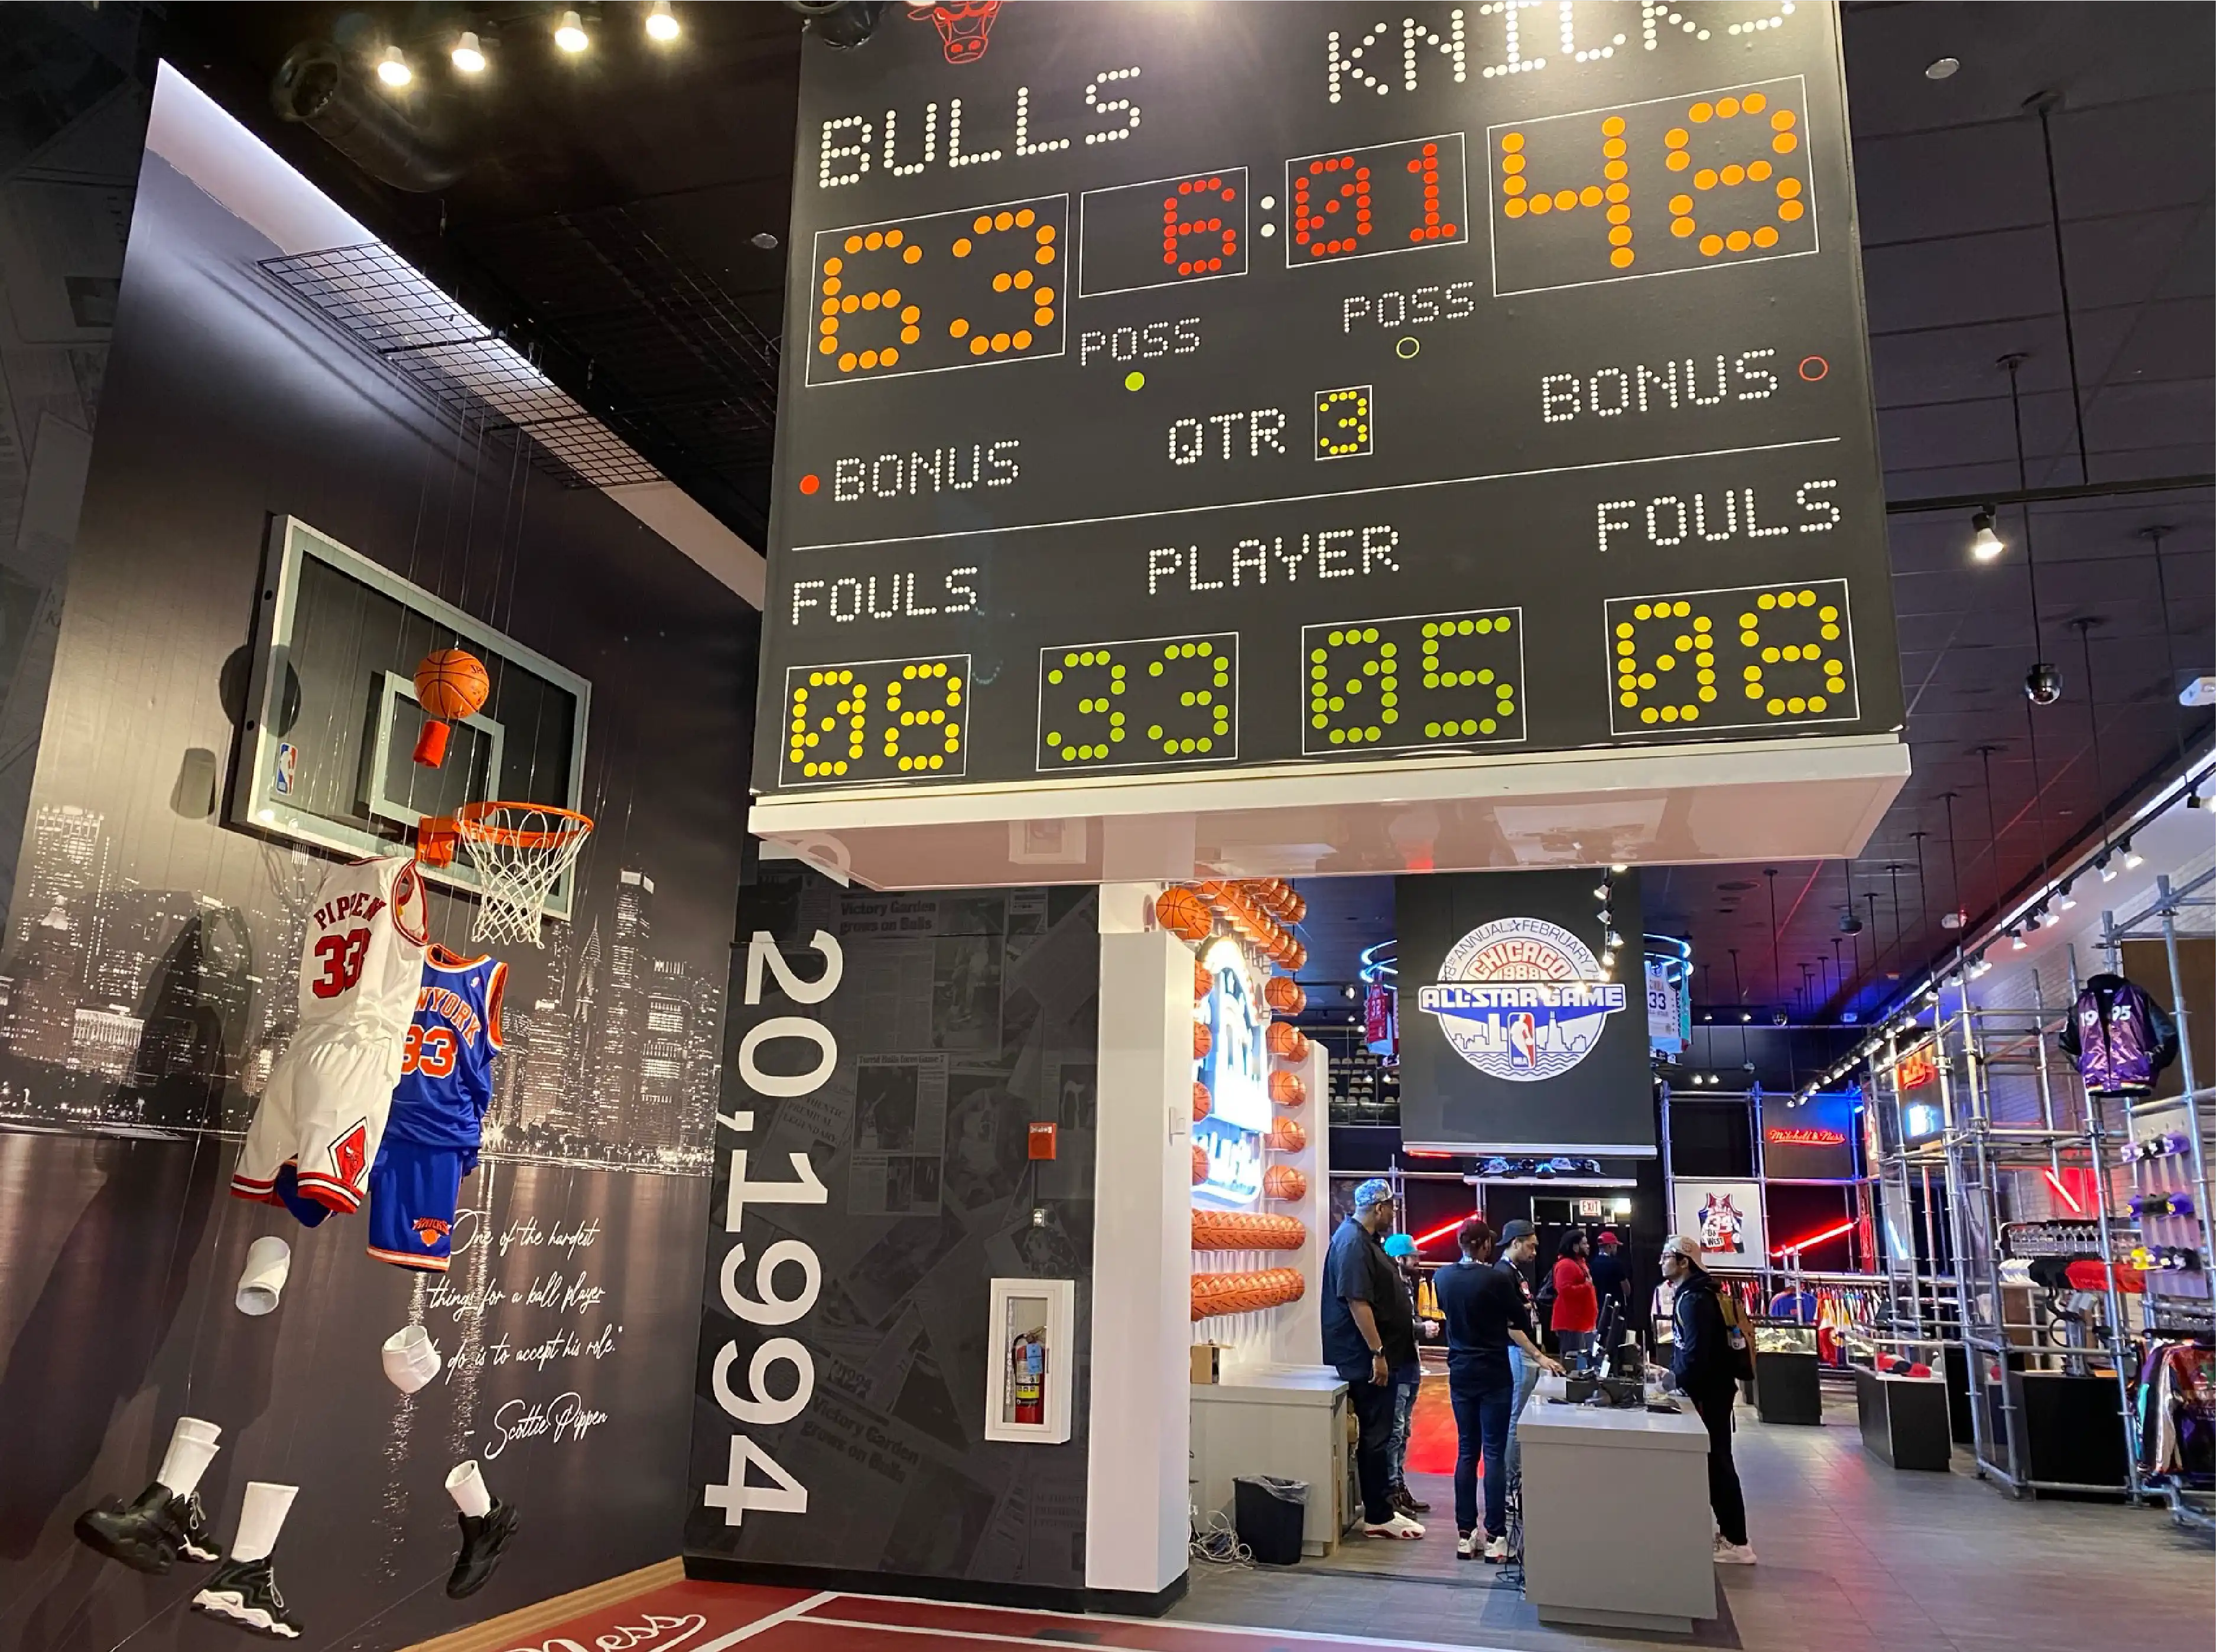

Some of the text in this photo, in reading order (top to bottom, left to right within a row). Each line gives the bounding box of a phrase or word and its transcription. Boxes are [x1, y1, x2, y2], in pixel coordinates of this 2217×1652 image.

[819, 66, 1141, 188] BULLS
[1503, 93, 1804, 269] 48
[819, 209, 1057, 372] 63
[1343, 281, 1475, 333] POSS
[1080, 317, 1201, 366] POSS
[1542, 349, 1777, 423] BONUS
[1168, 390, 1367, 464] QTR 3
[834, 439, 1020, 501] BONUS
[1597, 479, 1840, 551] FOULS
[1149, 525, 1400, 594] PLAYER
[792, 567, 978, 626] FOULS
[1311, 616, 1515, 744] 05
[1617, 590, 1846, 724] 08
[790, 662, 962, 777] 08
[1047, 642, 1228, 760] 33
[313, 927, 372, 999] 33
[1454, 921, 1508, 961] ANNUAL
[1522, 920, 1593, 964] FEBRUARY
[1467, 941, 1572, 980] CHICAGO
[1497, 964, 1540, 980] 1988
[1649, 992, 1666, 1010] 33
[2080, 1009, 2099, 1027] 19
[499, 1219, 518, 1256] of
[517, 1217, 543, 1247] the
[547, 1218, 601, 1260] hardest
[1582, 1201, 1598, 1212] EXIT
[477, 1278, 506, 1315] for
[512, 1292, 523, 1304] a
[525, 1271, 563, 1308] ball
[561, 1271, 606, 1314] player
[490, 1333, 511, 1365] to
[516, 1328, 565, 1371] accept
[563, 1331, 581, 1357] his
[484, 1391, 608, 1460] Scottie Pippen
